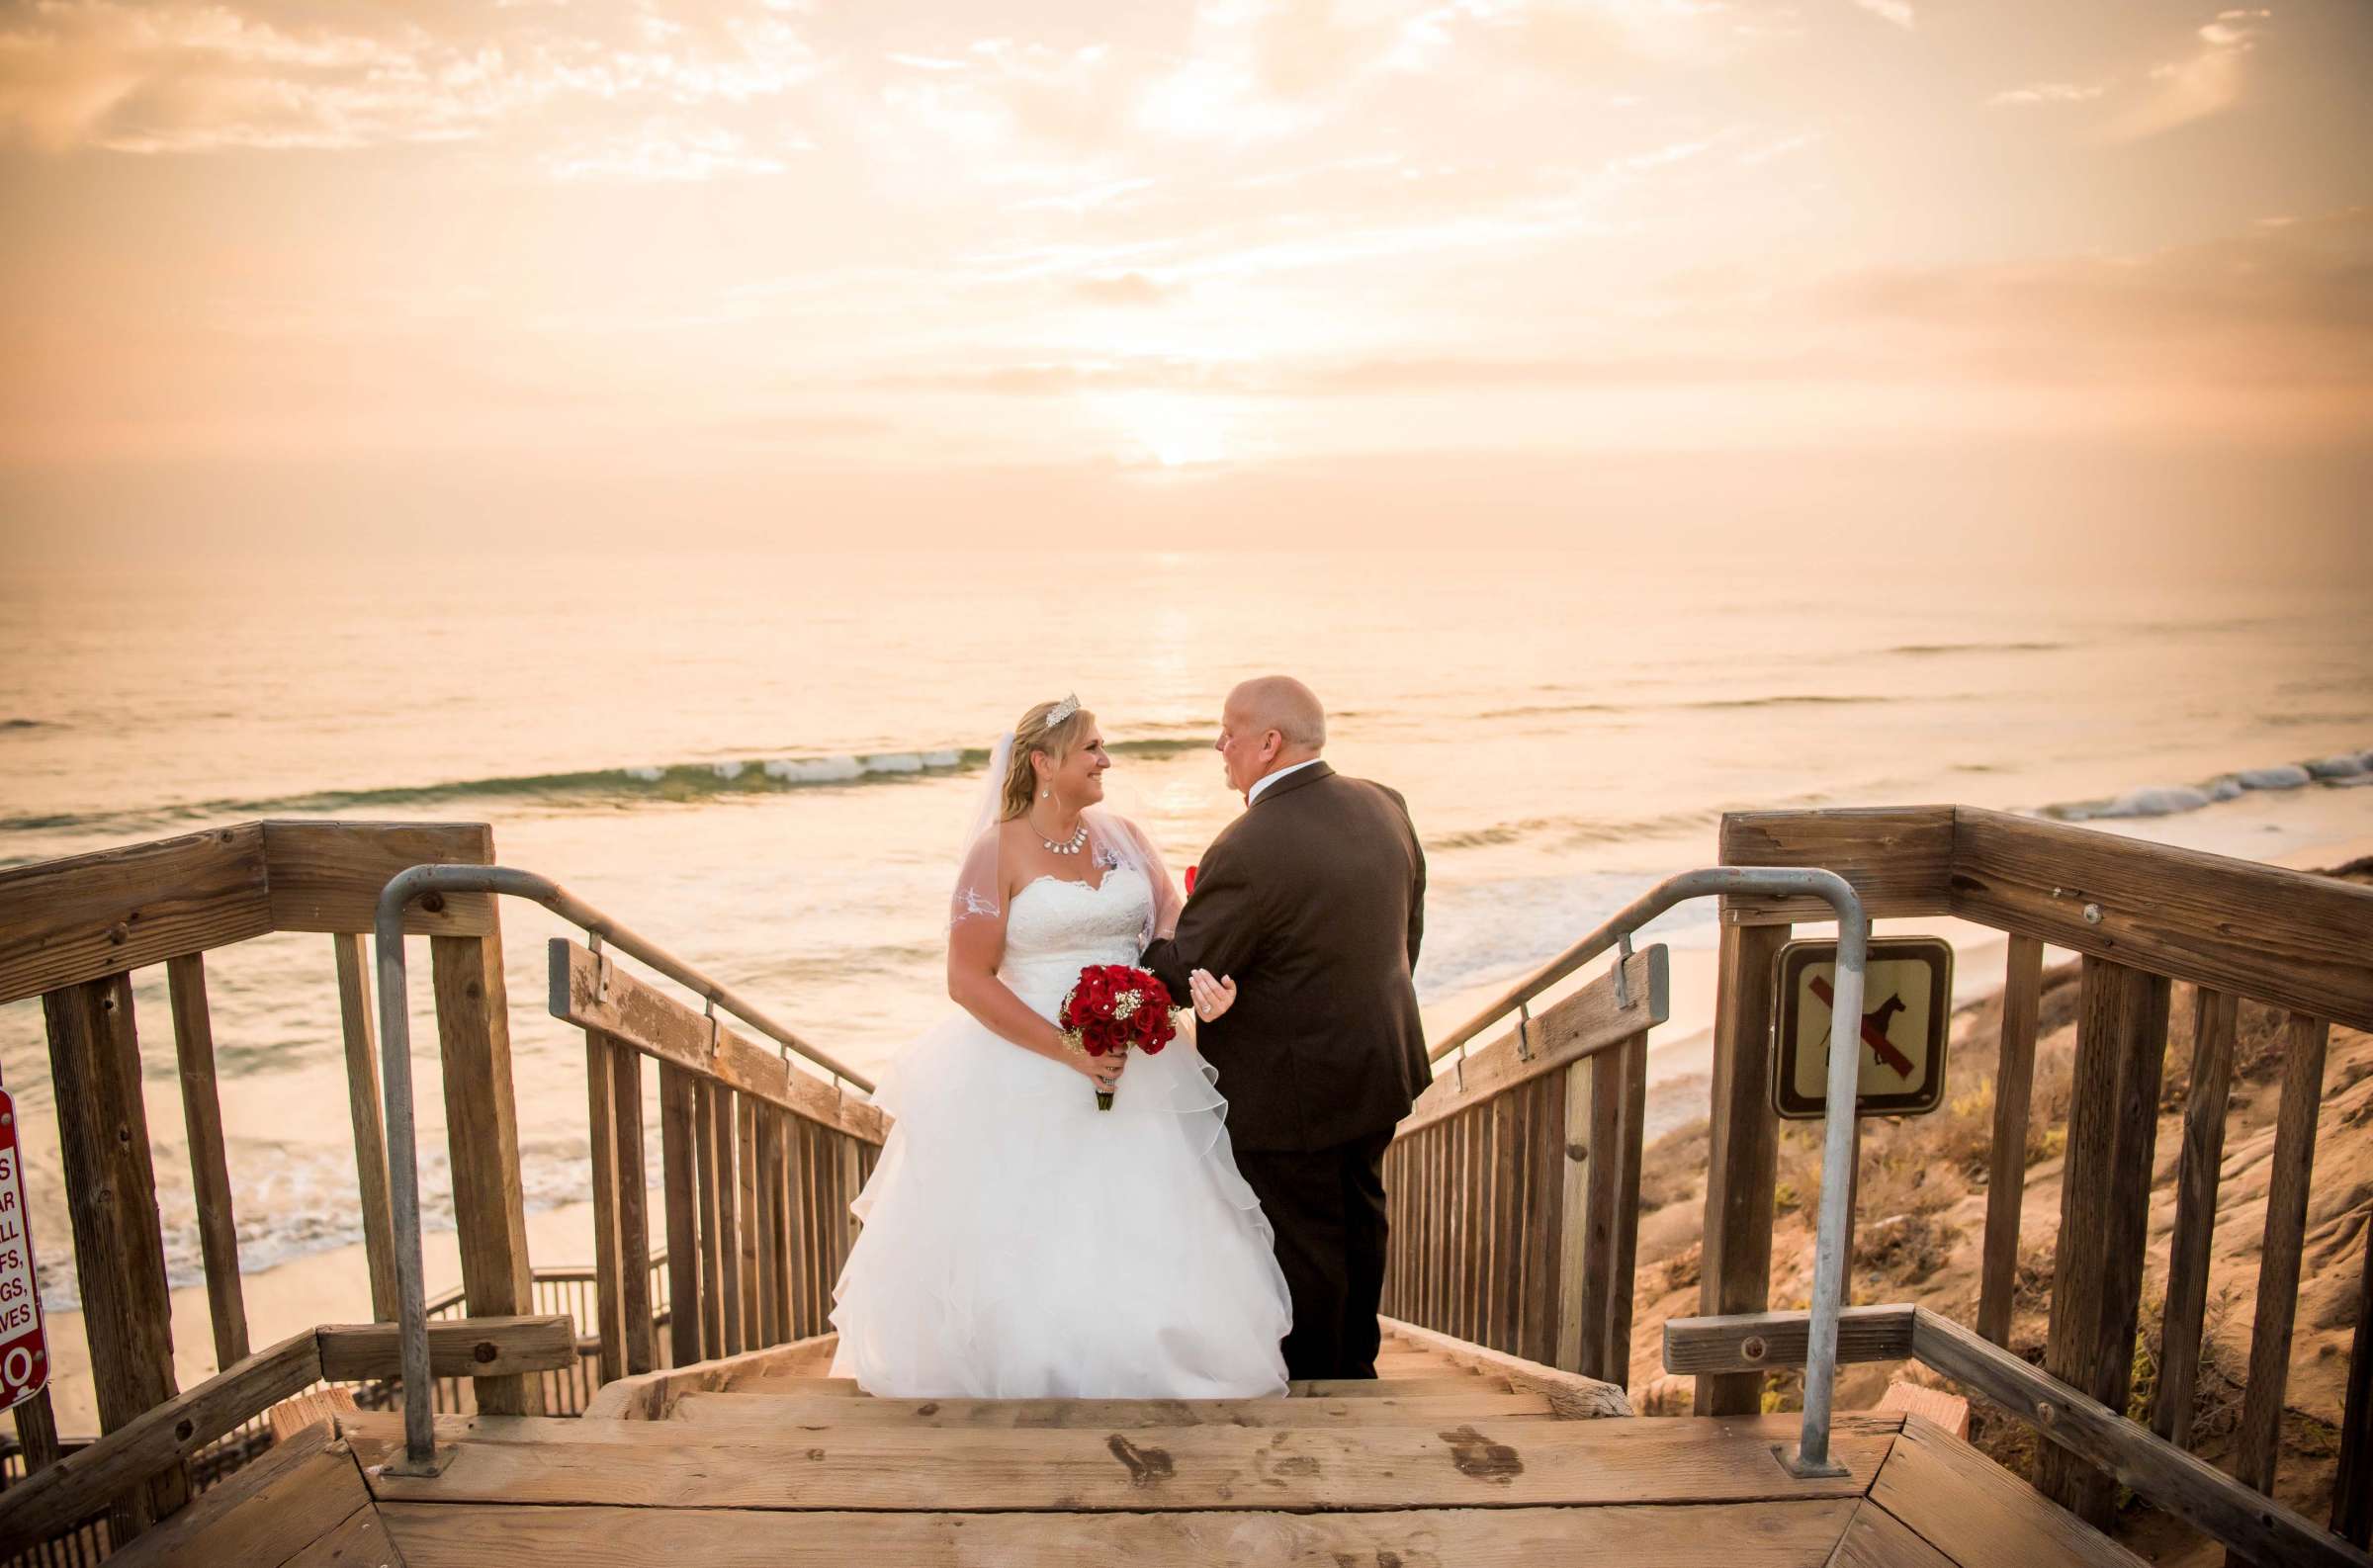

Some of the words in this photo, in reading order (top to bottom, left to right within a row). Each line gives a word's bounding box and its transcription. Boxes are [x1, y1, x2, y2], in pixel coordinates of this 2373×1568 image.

[0, 1277, 28, 1302] GS,
[0, 1303, 31, 1334] VES
[0, 1346, 33, 1395] O
